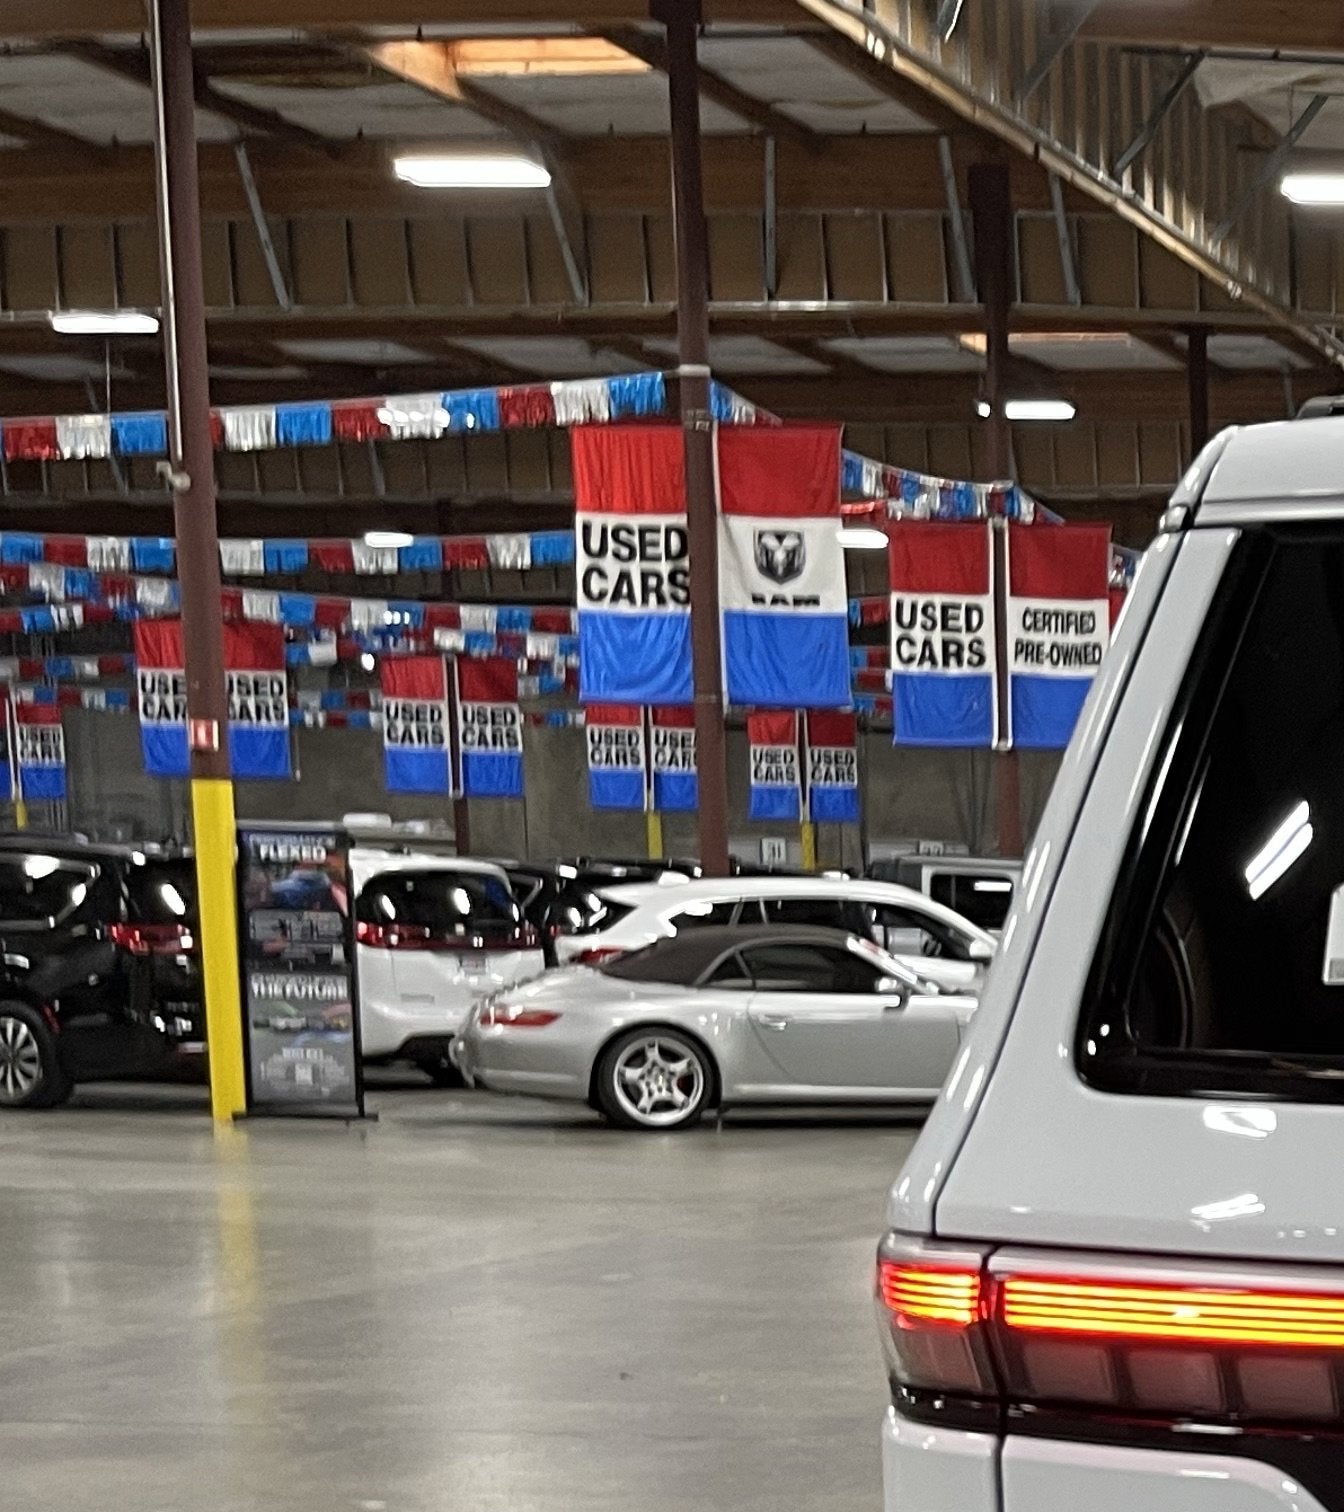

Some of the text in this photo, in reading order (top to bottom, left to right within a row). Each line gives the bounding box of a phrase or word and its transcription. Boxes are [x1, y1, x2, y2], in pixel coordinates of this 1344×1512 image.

[582, 520, 688, 563] USED
[582, 563, 690, 607] CARS
[895, 600, 984, 633] USED
[1022, 606, 1096, 635] CERTIFIED
[896, 634, 986, 668] CARS
[1014, 638, 1102, 666] PRE-OWNED
[140, 673, 187, 696] USE
[142, 697, 187, 721] CAR
[386, 703, 442, 723] USED
[462, 705, 516, 726] USED
[387, 722, 444, 746] CARS
[462, 725, 518, 748] CARS
[590, 728, 639, 747] USED
[655, 729, 697, 749] USE
[591, 747, 640, 767] CARS
[655, 749, 697, 769] CAR
[753, 748, 795, 764] USED
[811, 749, 855, 766] USED
[753, 765, 796, 783] CARS
[811, 766, 856, 784] CARS
